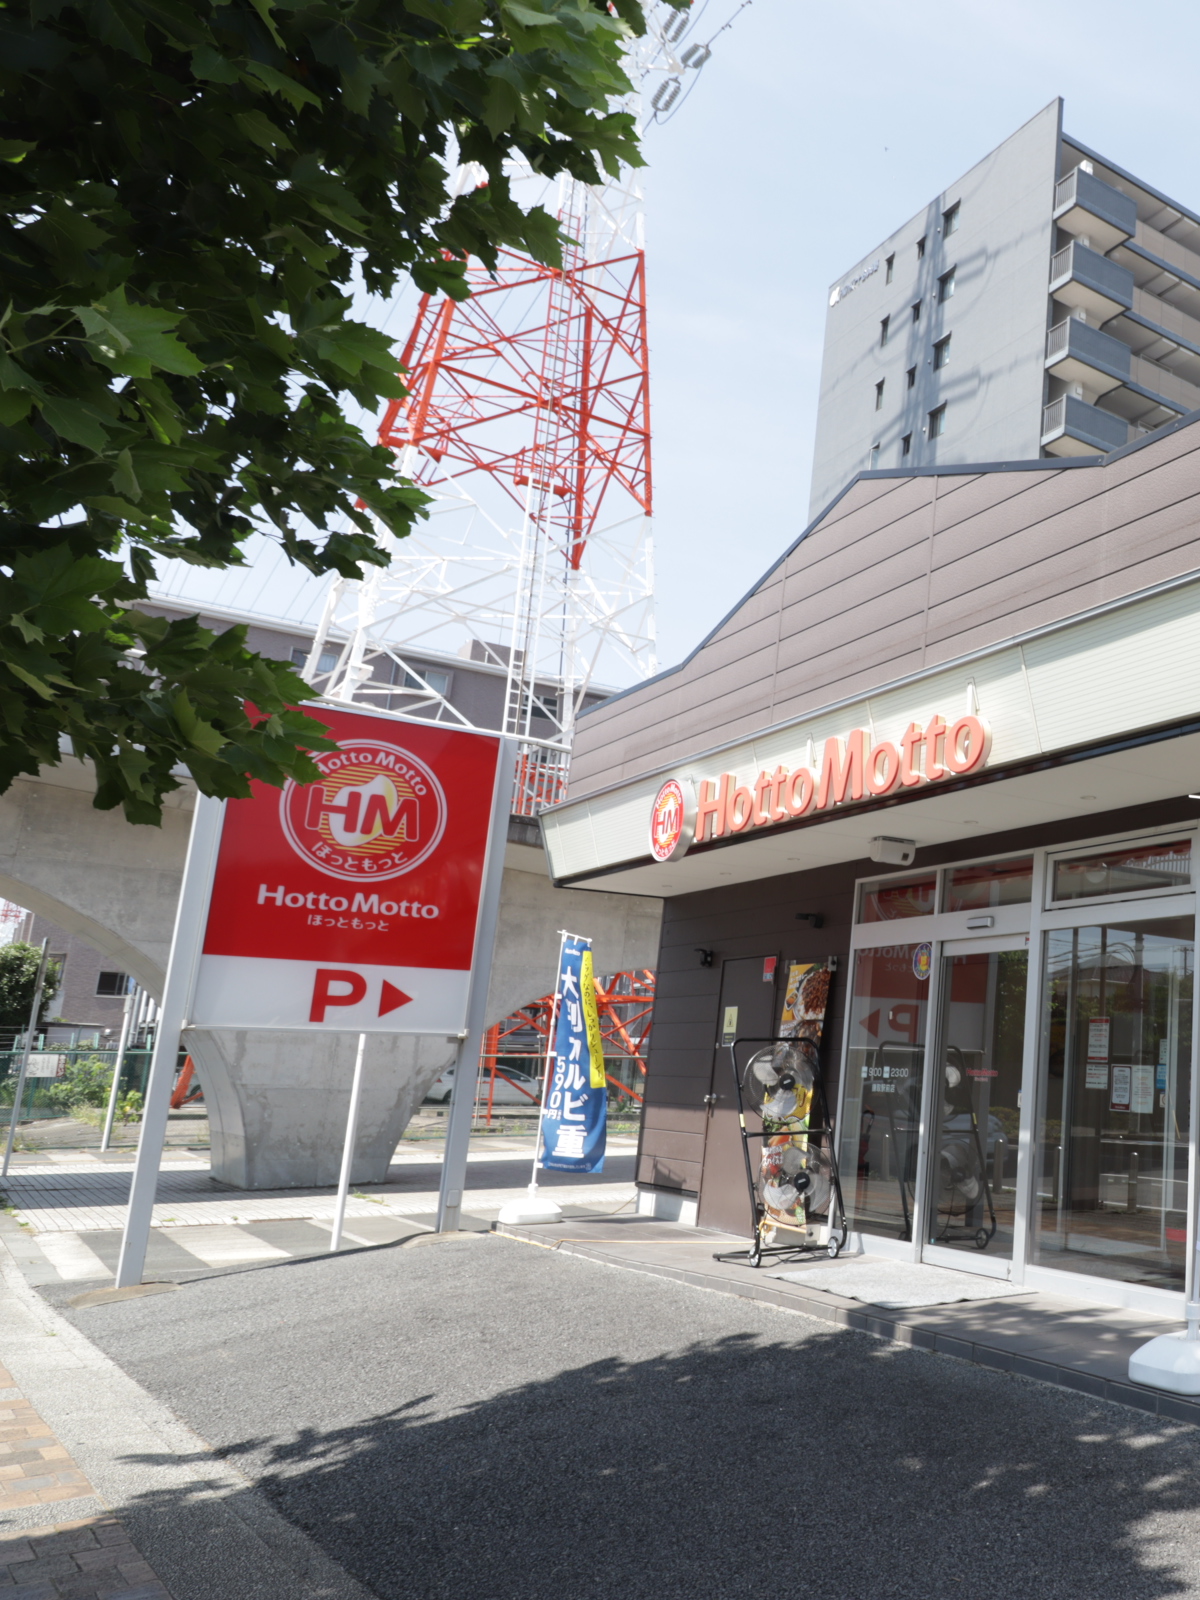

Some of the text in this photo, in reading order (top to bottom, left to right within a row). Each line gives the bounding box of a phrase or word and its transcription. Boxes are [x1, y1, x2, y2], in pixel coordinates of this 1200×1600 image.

[695, 714, 989, 841] HottoMotto
[304, 784, 420, 842] HM
[311, 841, 408, 872] ほっともっと
[257, 883, 440, 919] HottoMotto
[307, 914, 389, 932] ほっともっと
[309, 968, 367, 1023] P
